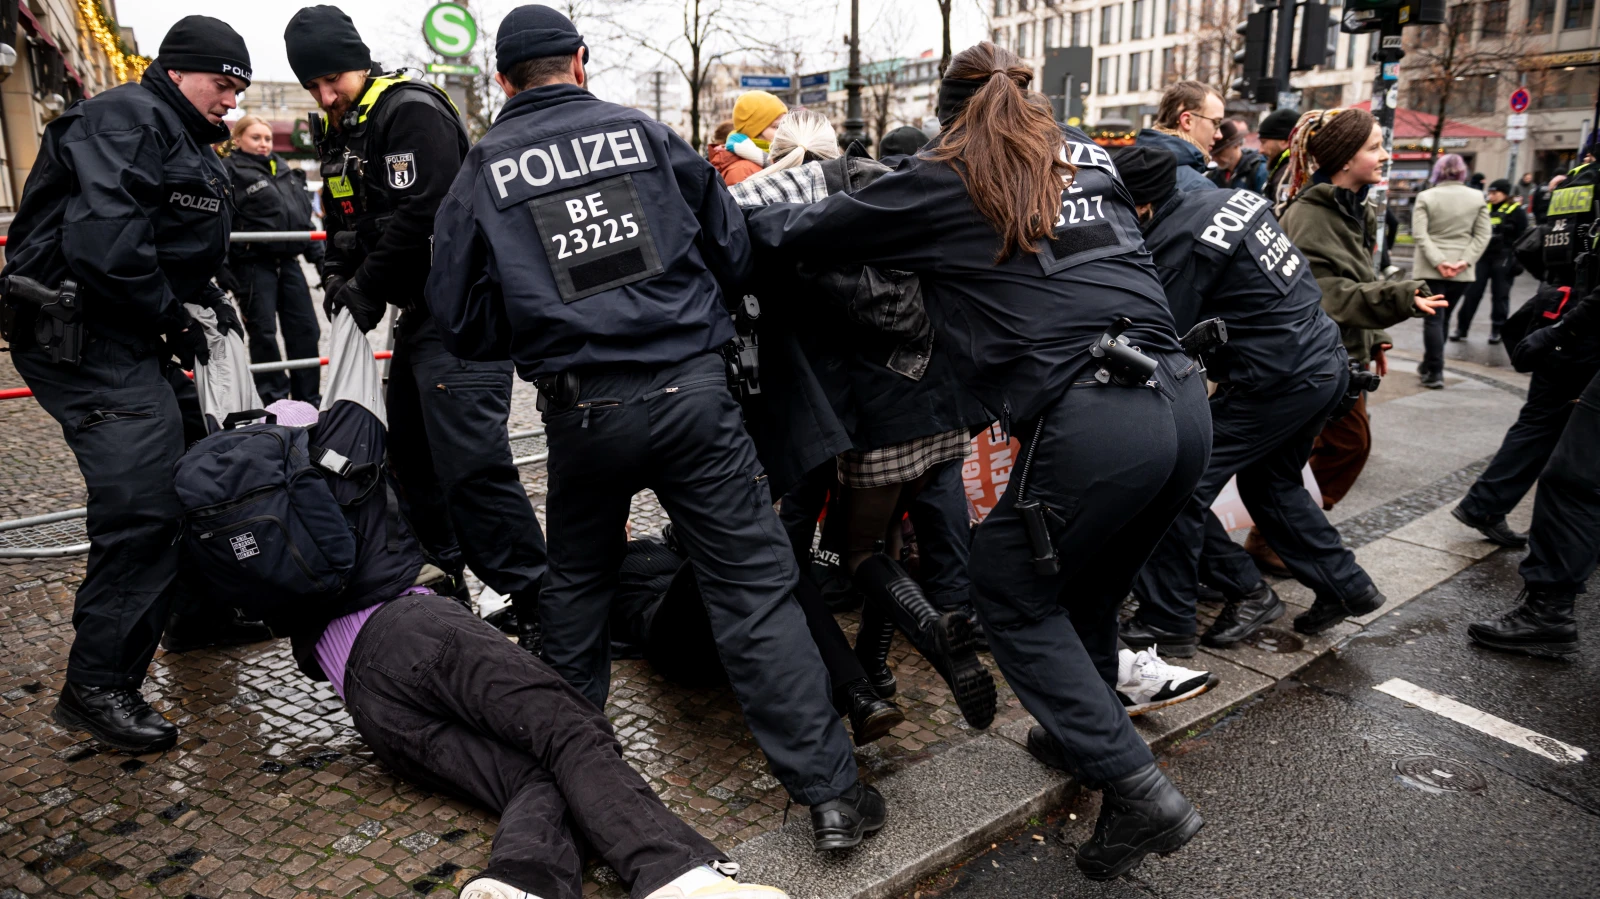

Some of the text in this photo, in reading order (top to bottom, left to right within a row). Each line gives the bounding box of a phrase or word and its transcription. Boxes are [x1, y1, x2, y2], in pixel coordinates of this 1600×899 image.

[432, 6, 471, 54] S
[387, 154, 412, 165] POLIZEI
[489, 127, 649, 200] POLIZEI
[169, 191, 220, 213] POLIZEI
[341, 200, 354, 214] 23
[565, 191, 609, 224] BE
[551, 212, 640, 260] 23225
[1254, 221, 1277, 247] BE
[1543, 231, 1571, 248] 31135
[1260, 232, 1292, 271] 21300
